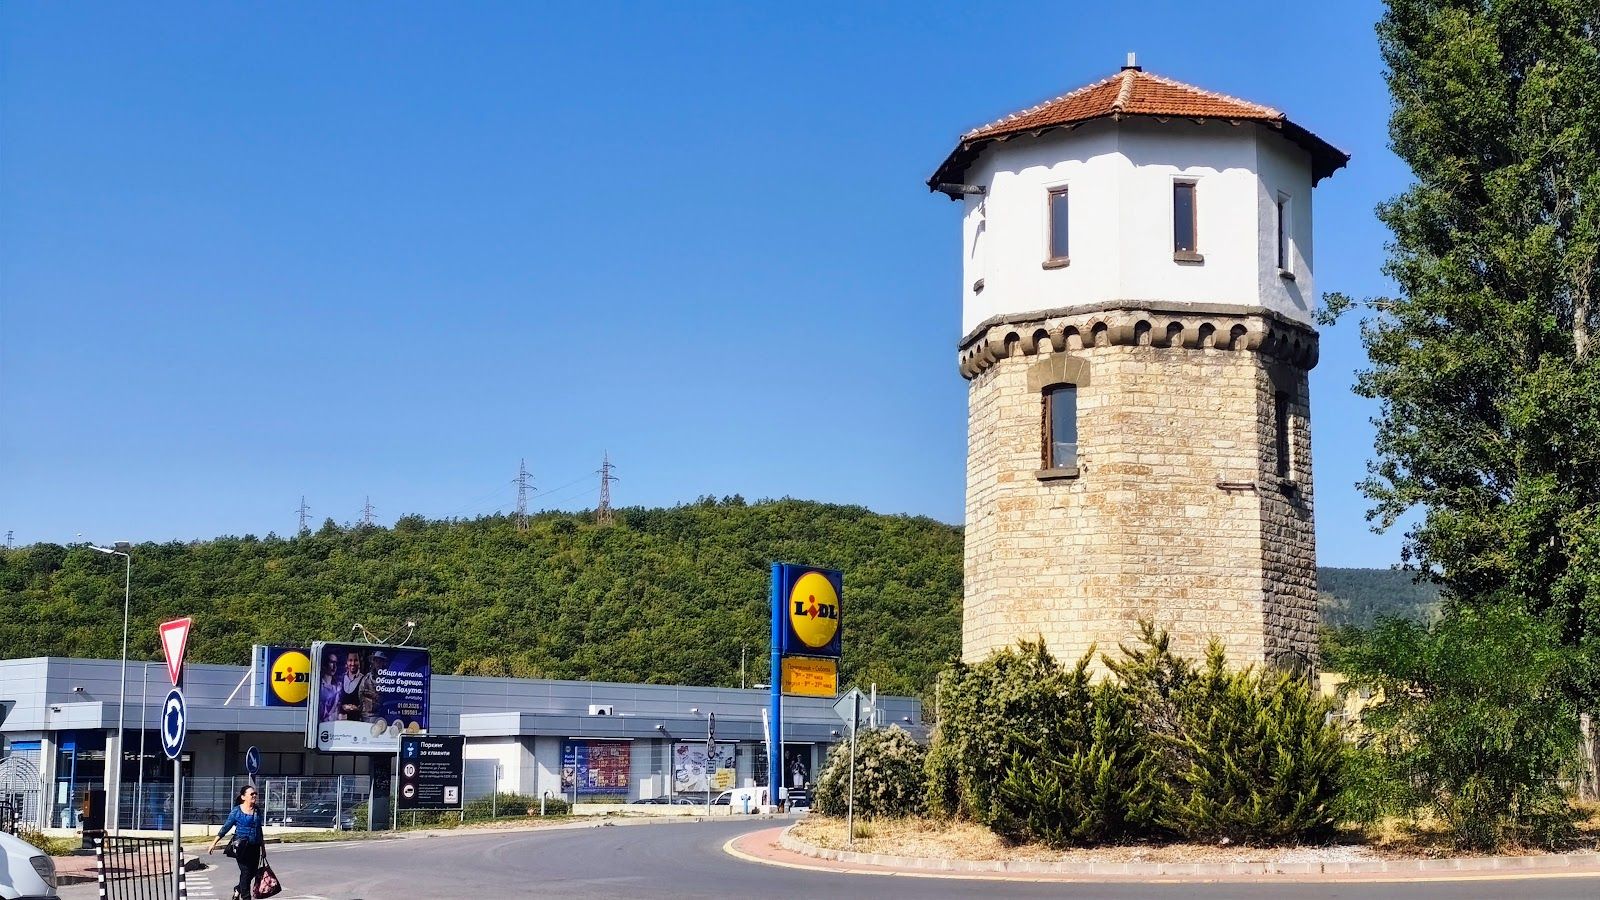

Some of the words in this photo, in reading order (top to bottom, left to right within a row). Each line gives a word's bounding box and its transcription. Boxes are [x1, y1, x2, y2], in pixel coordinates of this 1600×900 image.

[377, 669, 397, 677] Общо
[376, 677, 395, 685] Общо
[396, 678, 424, 686] бъдеще.
[376, 685, 395, 693] Обща
[406, 766, 414, 775] 10
